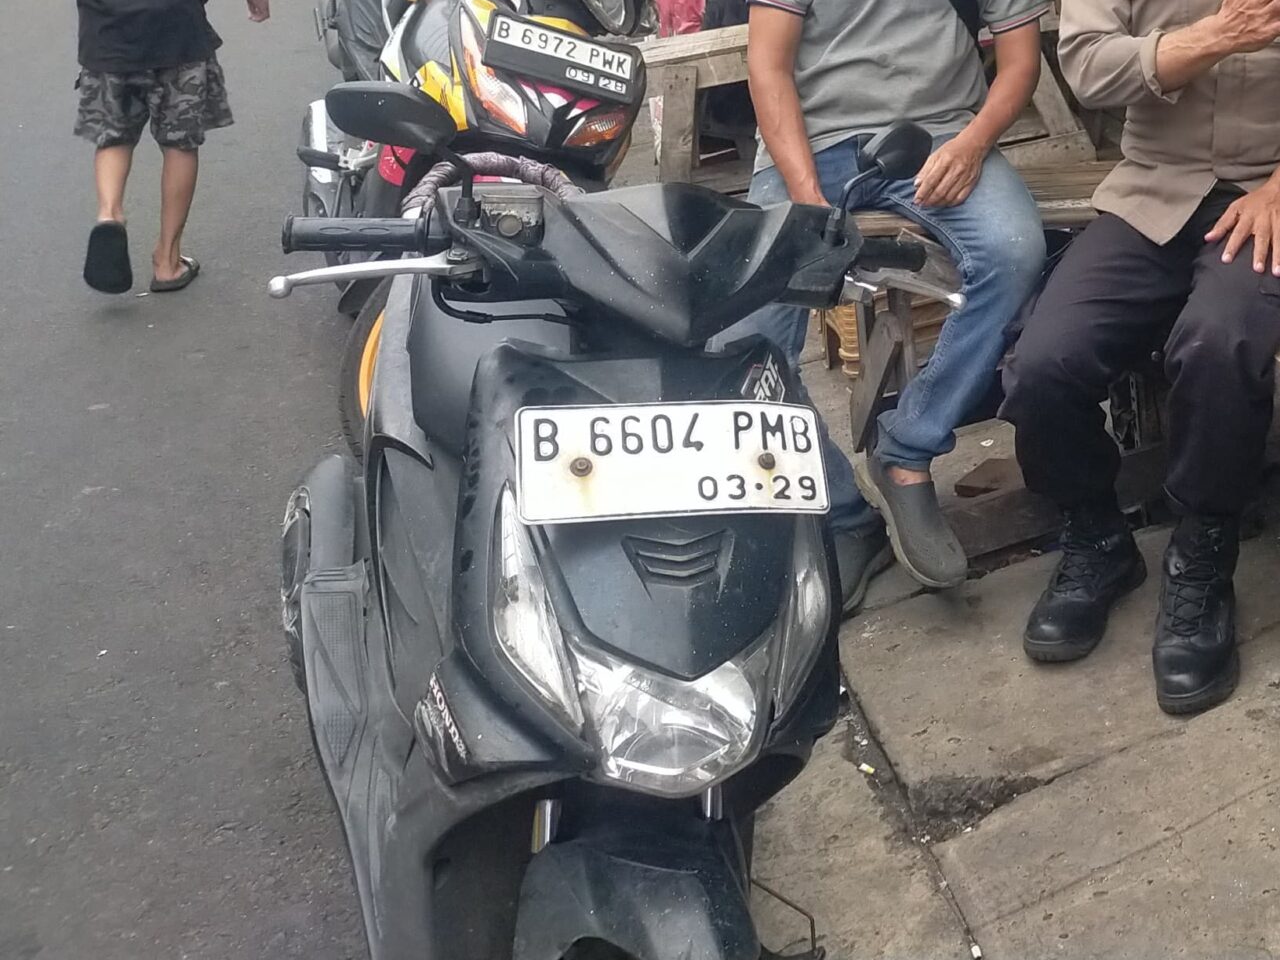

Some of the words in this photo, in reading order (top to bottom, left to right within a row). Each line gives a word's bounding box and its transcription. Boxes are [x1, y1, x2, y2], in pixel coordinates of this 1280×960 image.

[497, 21, 511, 39] B
[521, 28, 577, 59] 6972
[589, 47, 627, 75] PWK
[567, 67, 592, 83] 09
[533, 418, 559, 461] B
[590, 412, 704, 457] 6604
[733, 411, 812, 453] PMB
